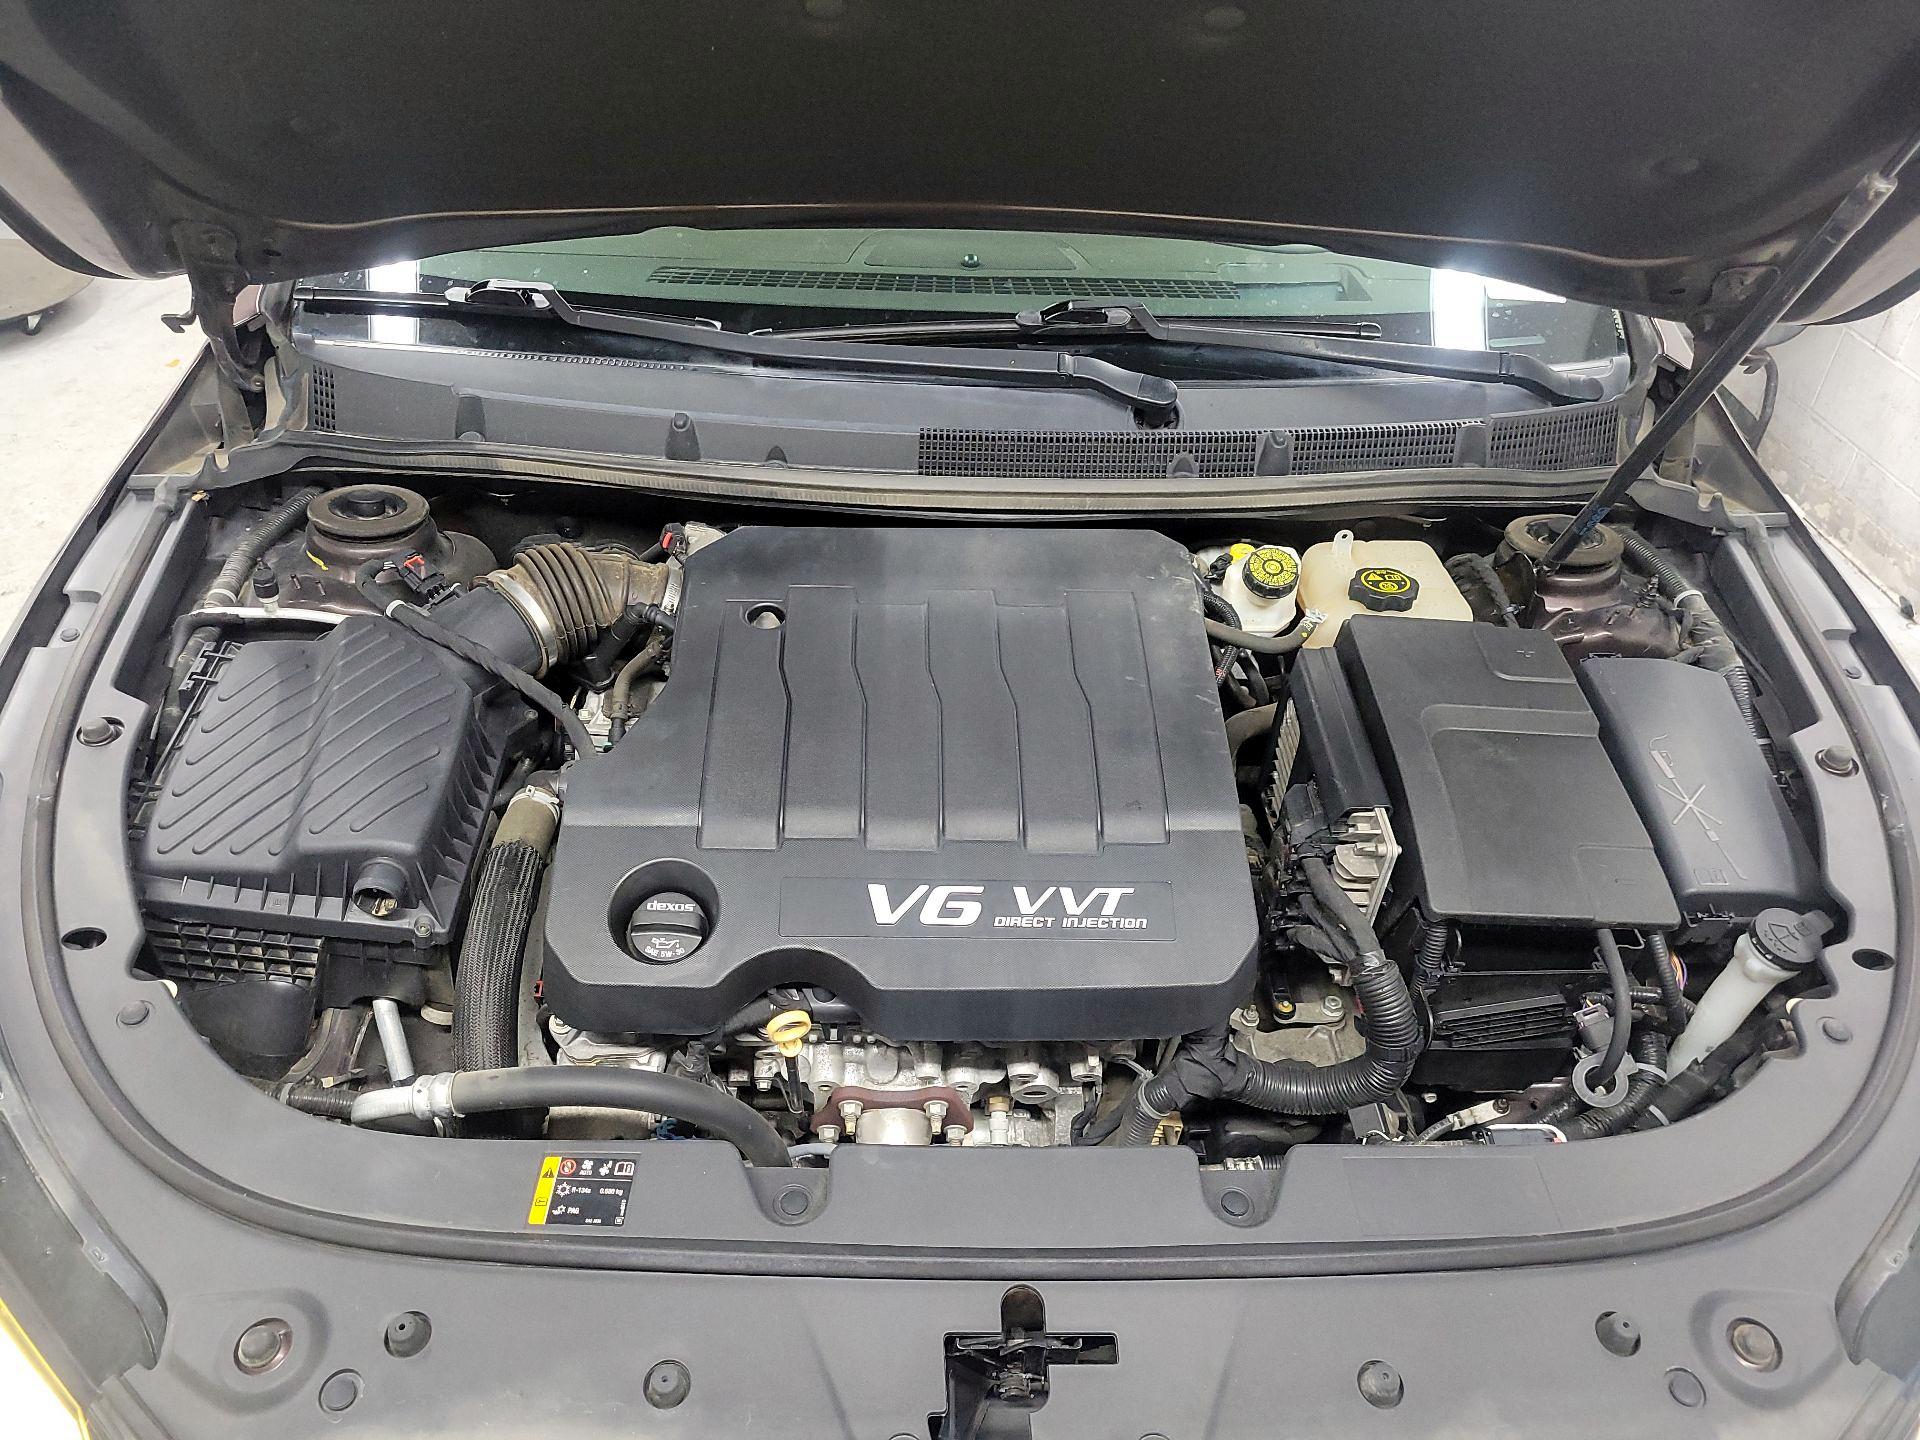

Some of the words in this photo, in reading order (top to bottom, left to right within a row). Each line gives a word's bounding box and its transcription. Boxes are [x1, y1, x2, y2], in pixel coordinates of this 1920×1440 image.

[646, 900, 696, 912] dexos
[867, 884, 985, 927] V6
[1012, 886, 1136, 916] VVT
[993, 916, 1056, 928] DIRECT
[1062, 917, 1148, 930] INJECTION
[644, 946, 659, 957] SAE
[660, 947, 685, 958] 5W-30
